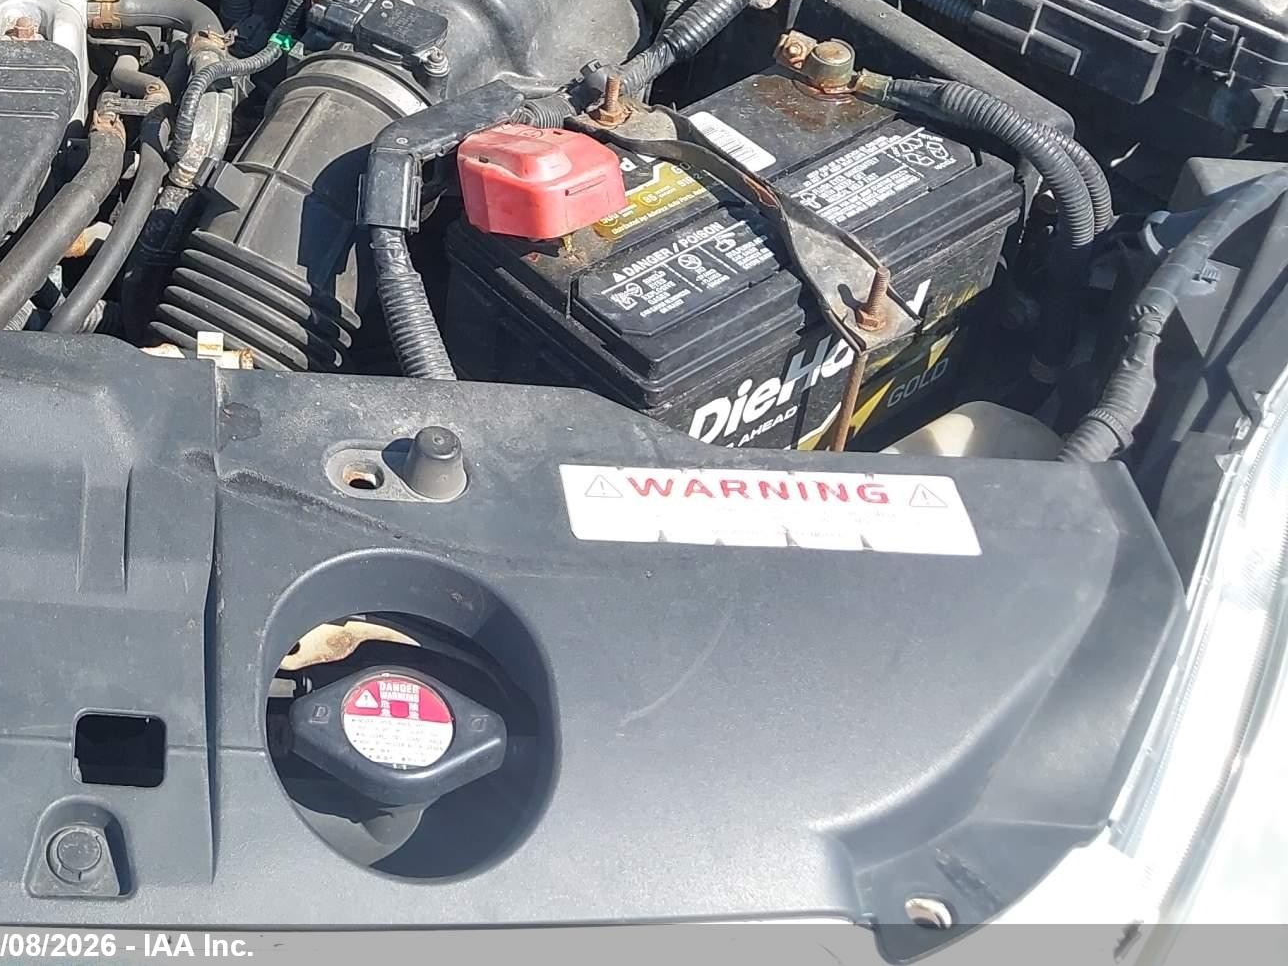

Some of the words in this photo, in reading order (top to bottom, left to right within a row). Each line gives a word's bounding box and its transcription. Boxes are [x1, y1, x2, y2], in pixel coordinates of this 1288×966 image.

[621, 247, 674, 277] DANGER
[679, 221, 725, 249] POISON
[887, 357, 950, 409] GOLD
[737, 405, 799, 448] AHEAD
[626, 476, 891, 505] WARNING
